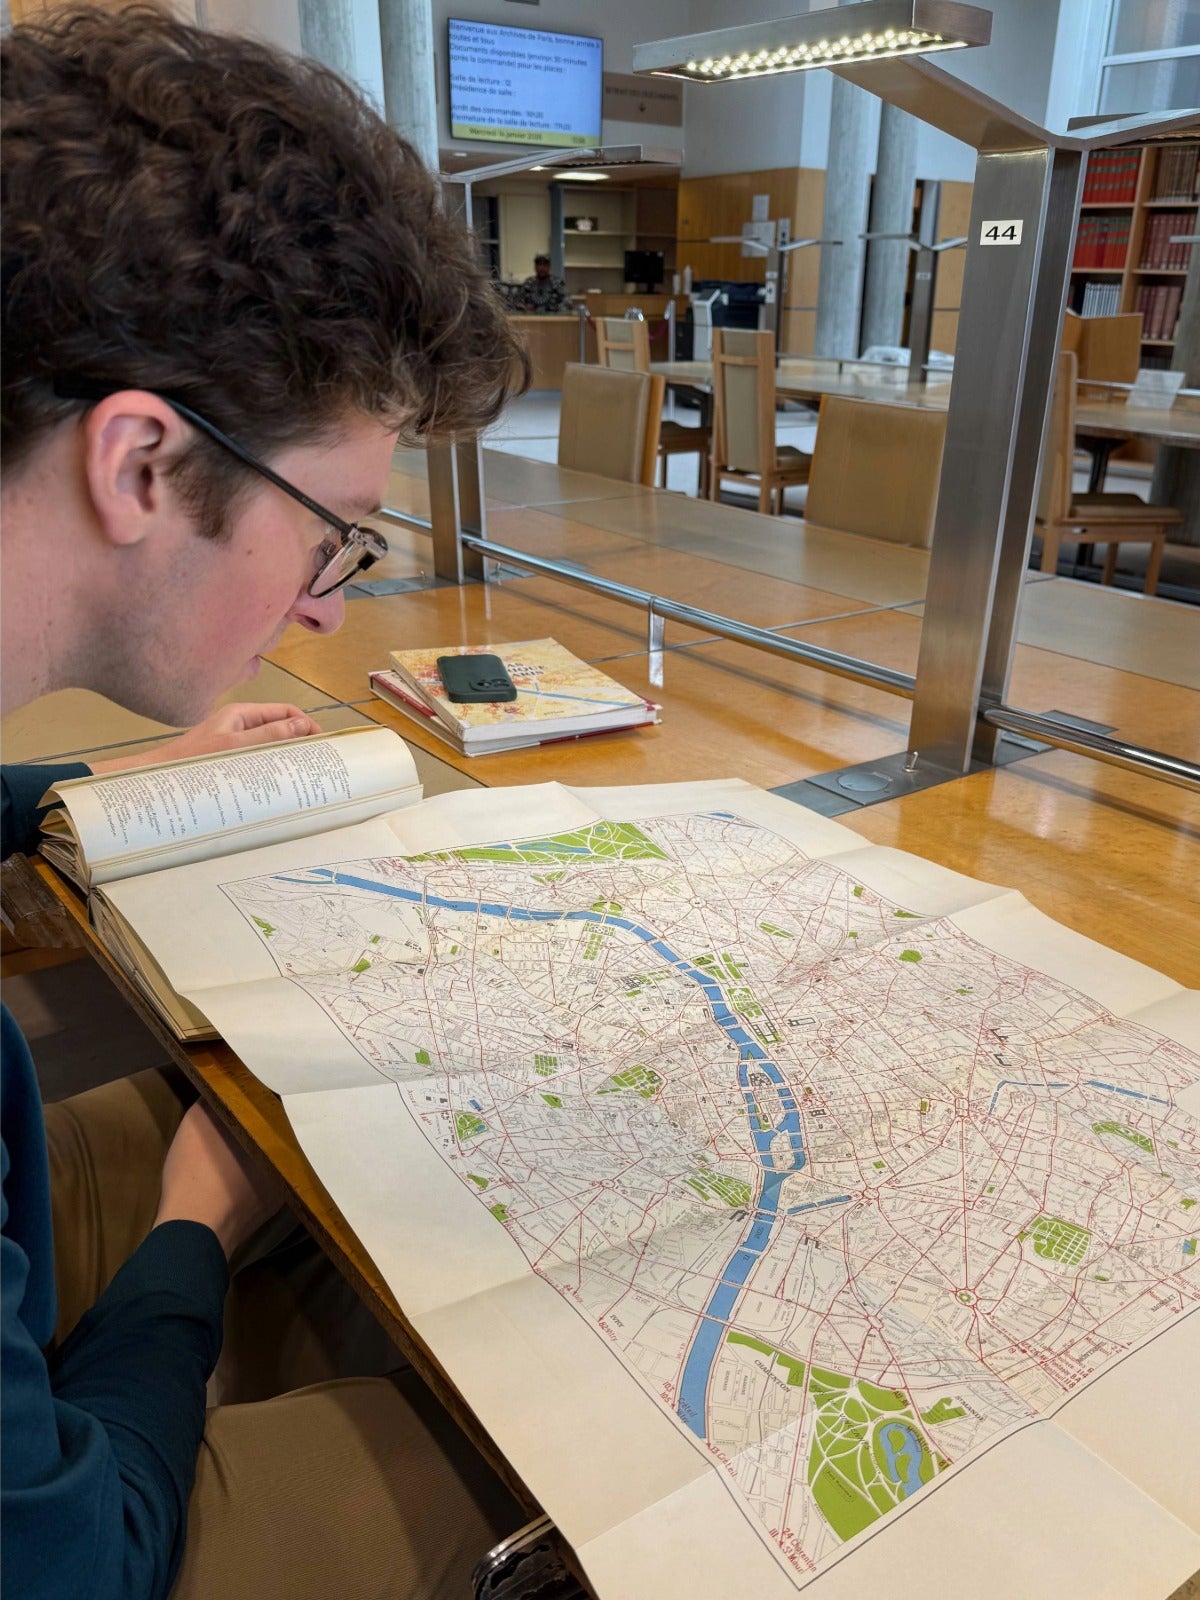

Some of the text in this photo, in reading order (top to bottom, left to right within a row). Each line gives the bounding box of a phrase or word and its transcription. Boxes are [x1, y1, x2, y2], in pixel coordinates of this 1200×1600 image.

[985, 225, 1017, 240] 44
[754, 1359, 792, 1394] CHARENTON
[782, 1527, 818, 1573] 24 Charenton
